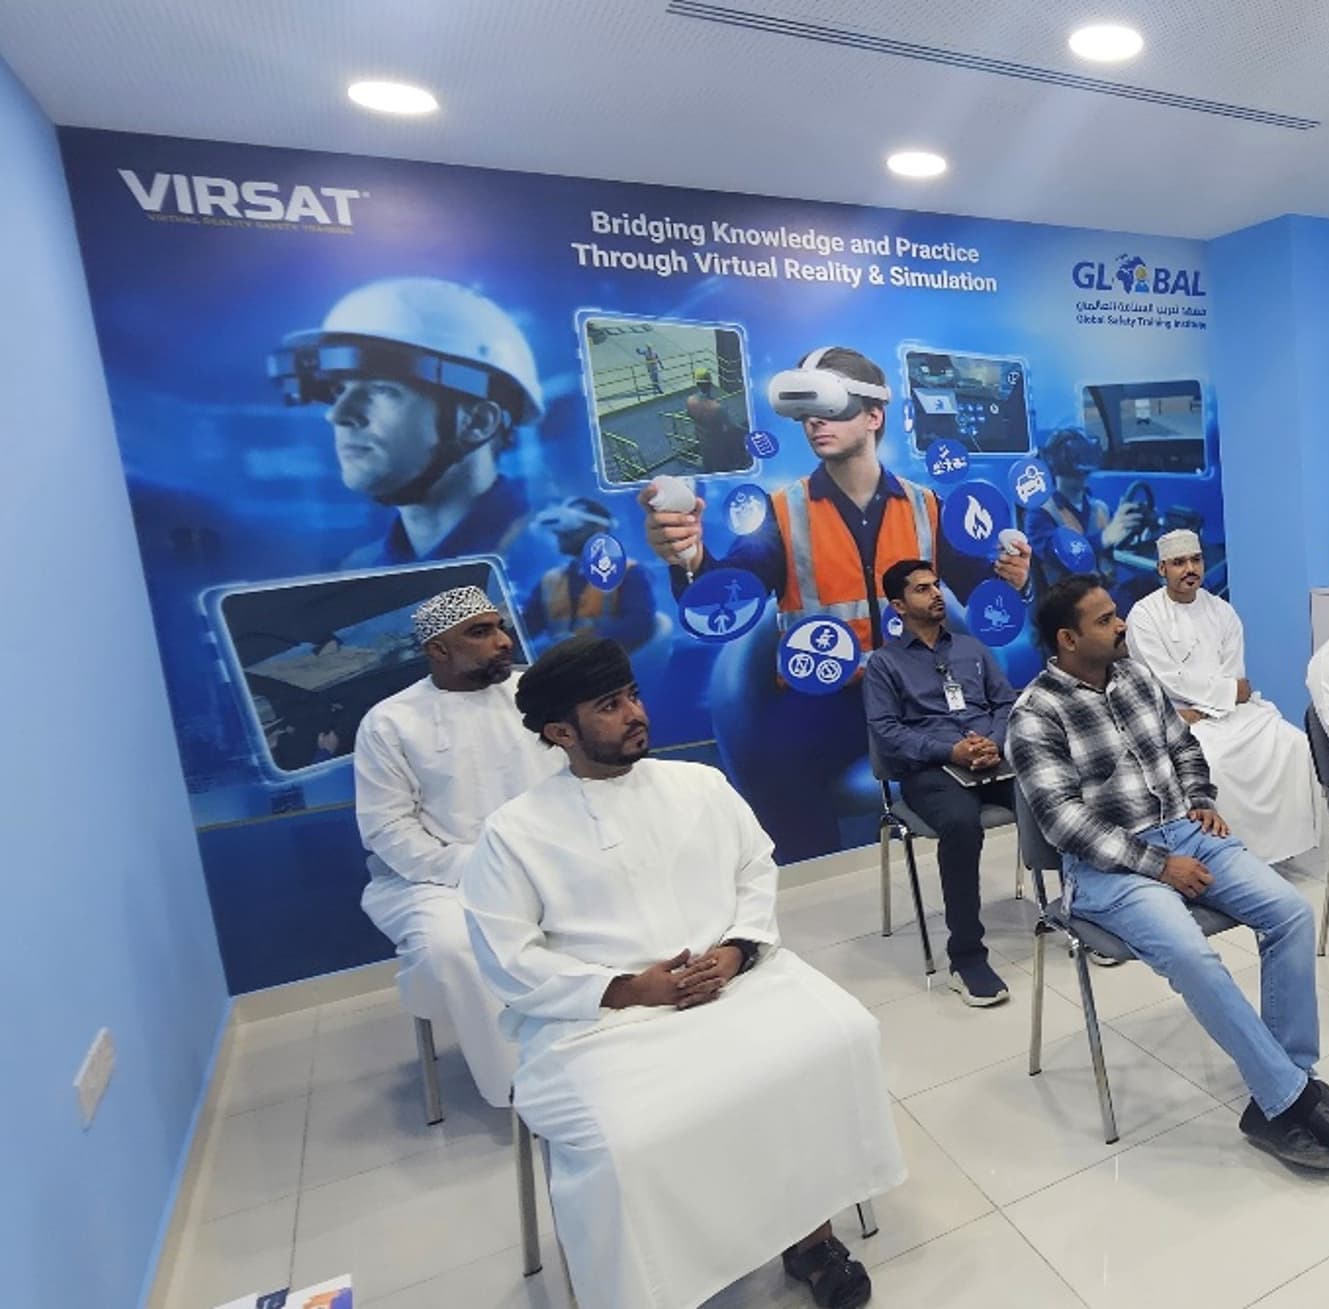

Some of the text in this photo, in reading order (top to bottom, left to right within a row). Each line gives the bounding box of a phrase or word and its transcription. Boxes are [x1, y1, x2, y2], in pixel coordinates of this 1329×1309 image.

[117, 168, 361, 226] VIRSAT
[591, 211, 979, 263] Bridging Knowledge and Practice
[571, 242, 997, 292] Through Virtual Reality & Simulation
[1076, 314, 1104, 325] Global
[1107, 314, 1136, 328] Safety
[1137, 316, 1171, 330] Training
